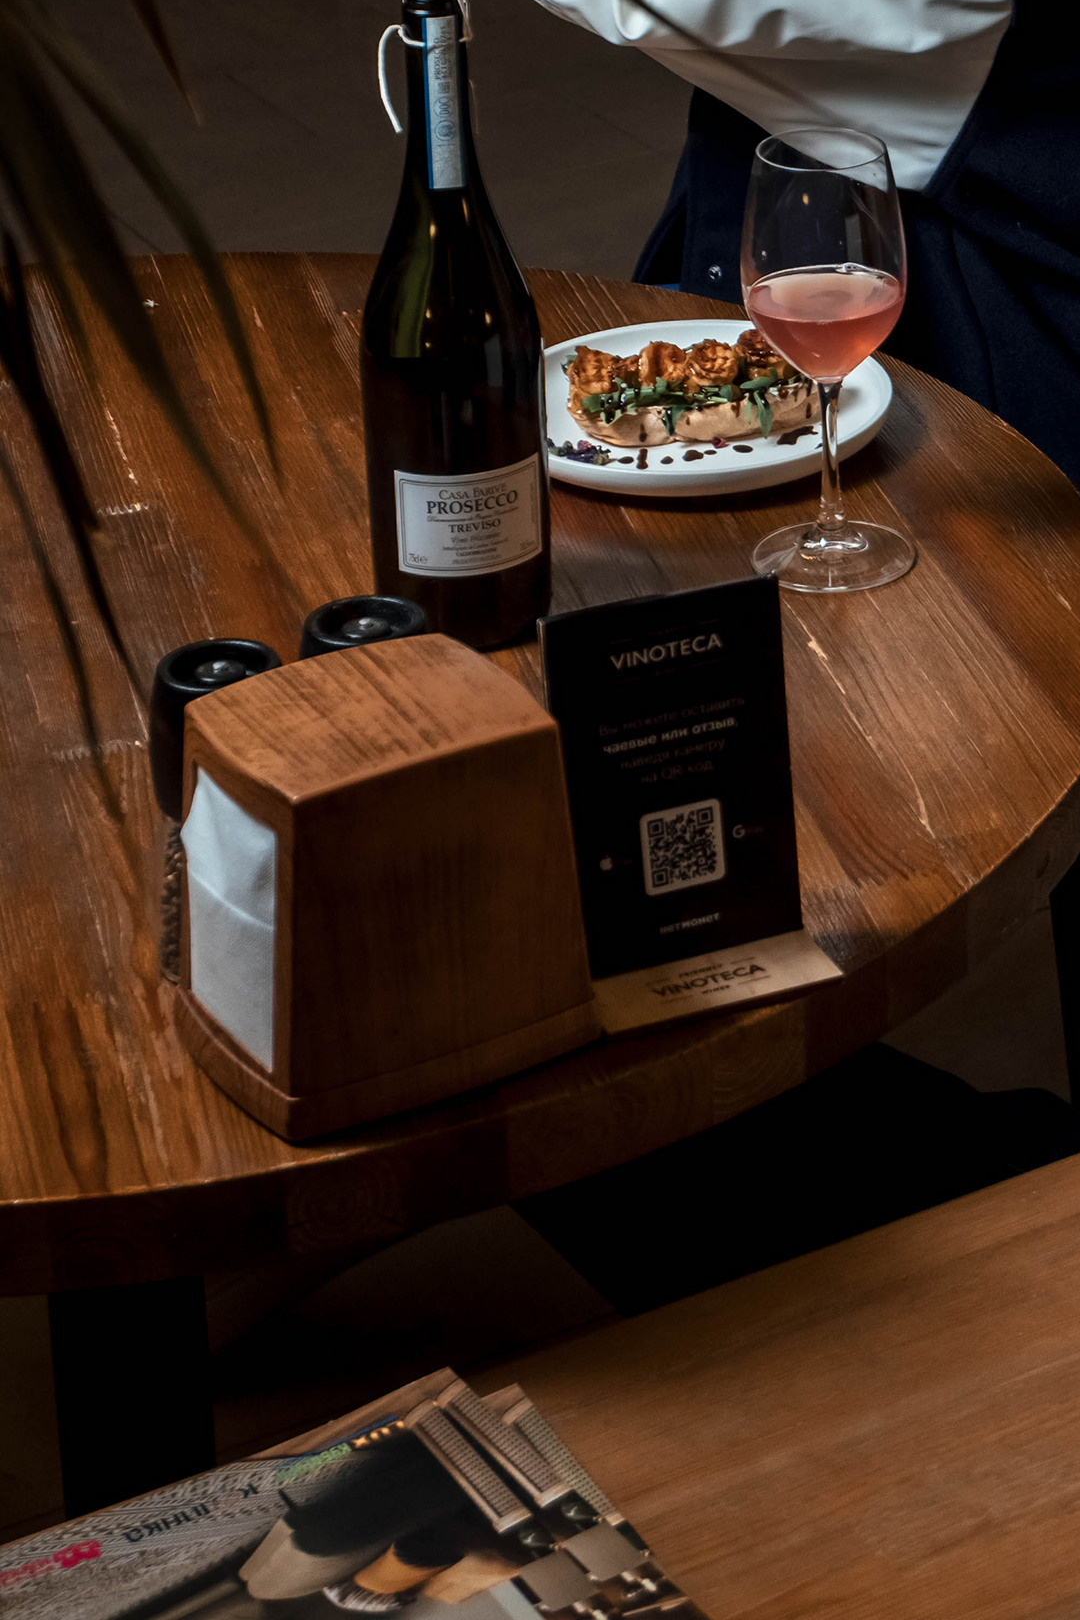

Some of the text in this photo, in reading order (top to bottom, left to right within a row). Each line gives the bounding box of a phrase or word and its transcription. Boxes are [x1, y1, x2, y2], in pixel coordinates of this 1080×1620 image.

[426, 489, 518, 515] PROSECCO
[438, 489, 470, 501] CASA
[448, 518, 502, 534] TREVISO
[610, 632, 725, 671] VINOTECA
[599, 723, 618, 737] Вы
[602, 733, 660, 756] чаевые
[661, 728, 690, 741] или
[660, 762, 685, 781] QR
[650, 965, 764, 996] VINOTECA
